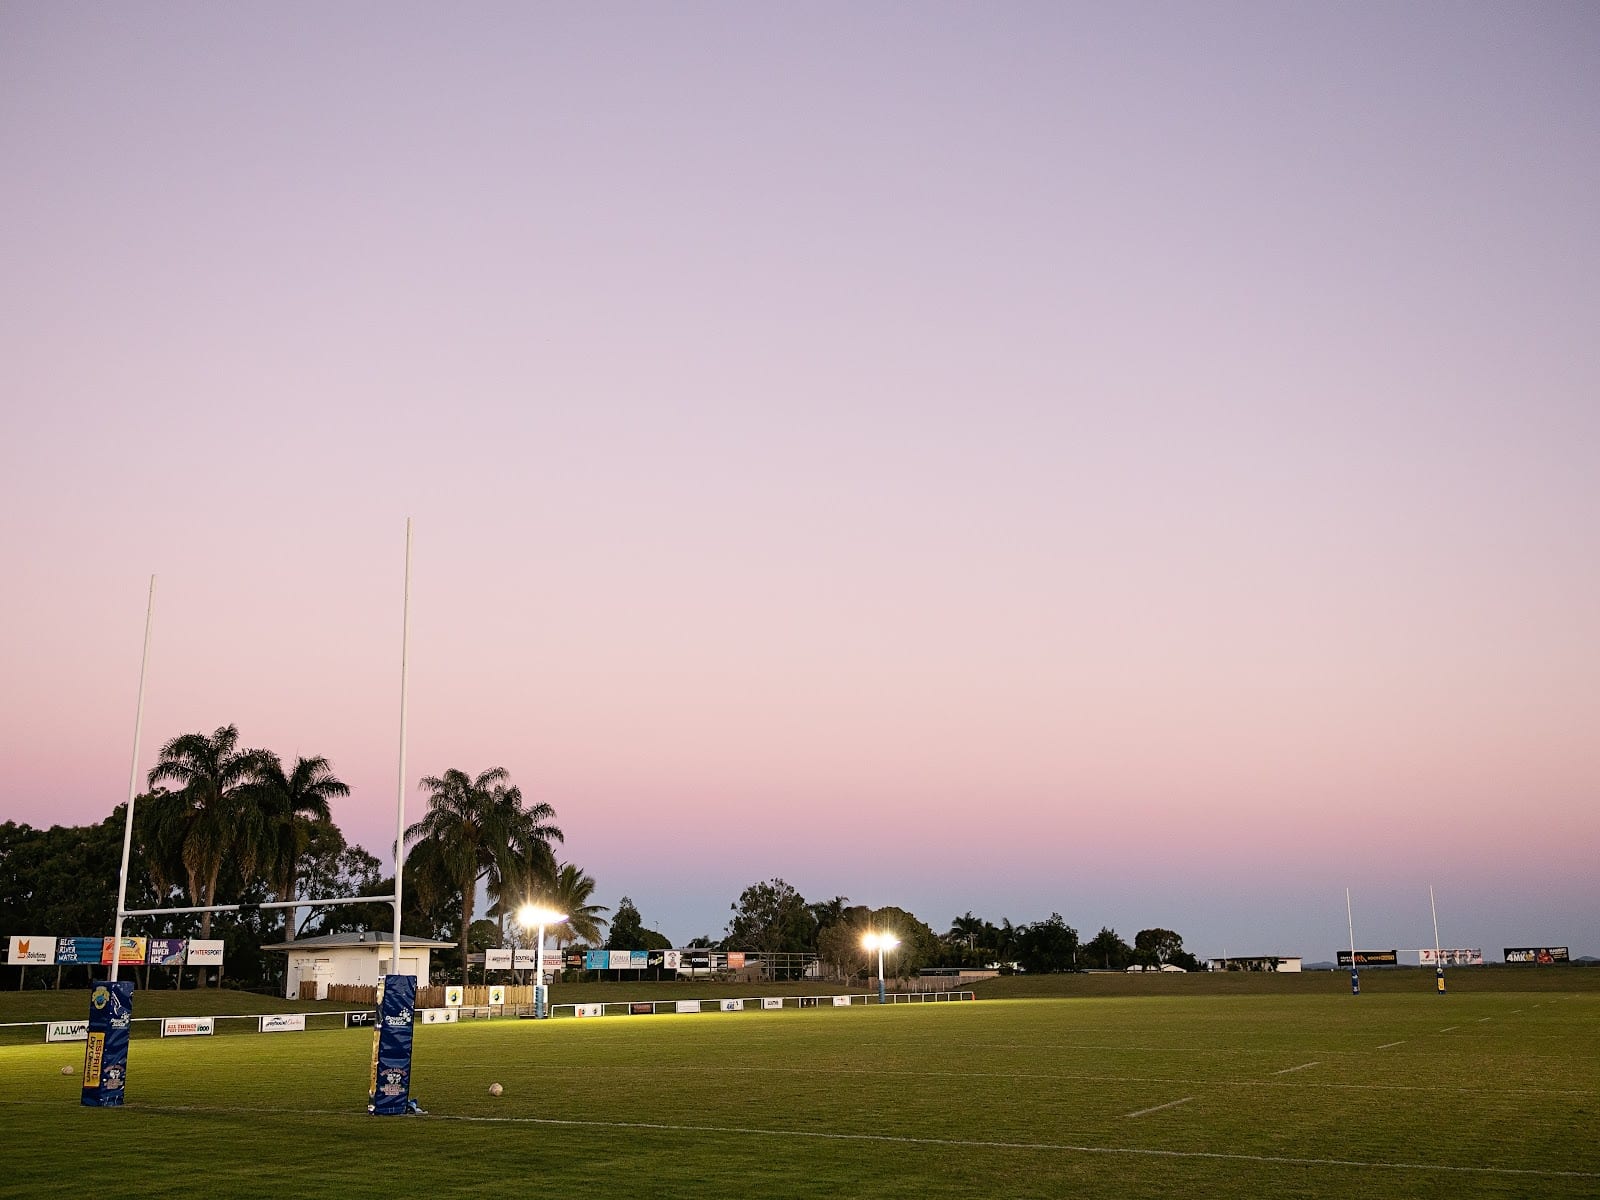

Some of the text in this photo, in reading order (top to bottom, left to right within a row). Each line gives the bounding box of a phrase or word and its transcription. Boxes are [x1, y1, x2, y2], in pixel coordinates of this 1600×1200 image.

[152, 940, 169, 948] BLUE
[59, 946, 76, 954] RIVER
[151, 948, 169, 956] RIVER
[27, 951, 47, 960] Solutions
[58, 953, 78, 962] WATER
[150, 955, 163, 964] ICE
[92, 1039, 103, 1080] ESPRITE
